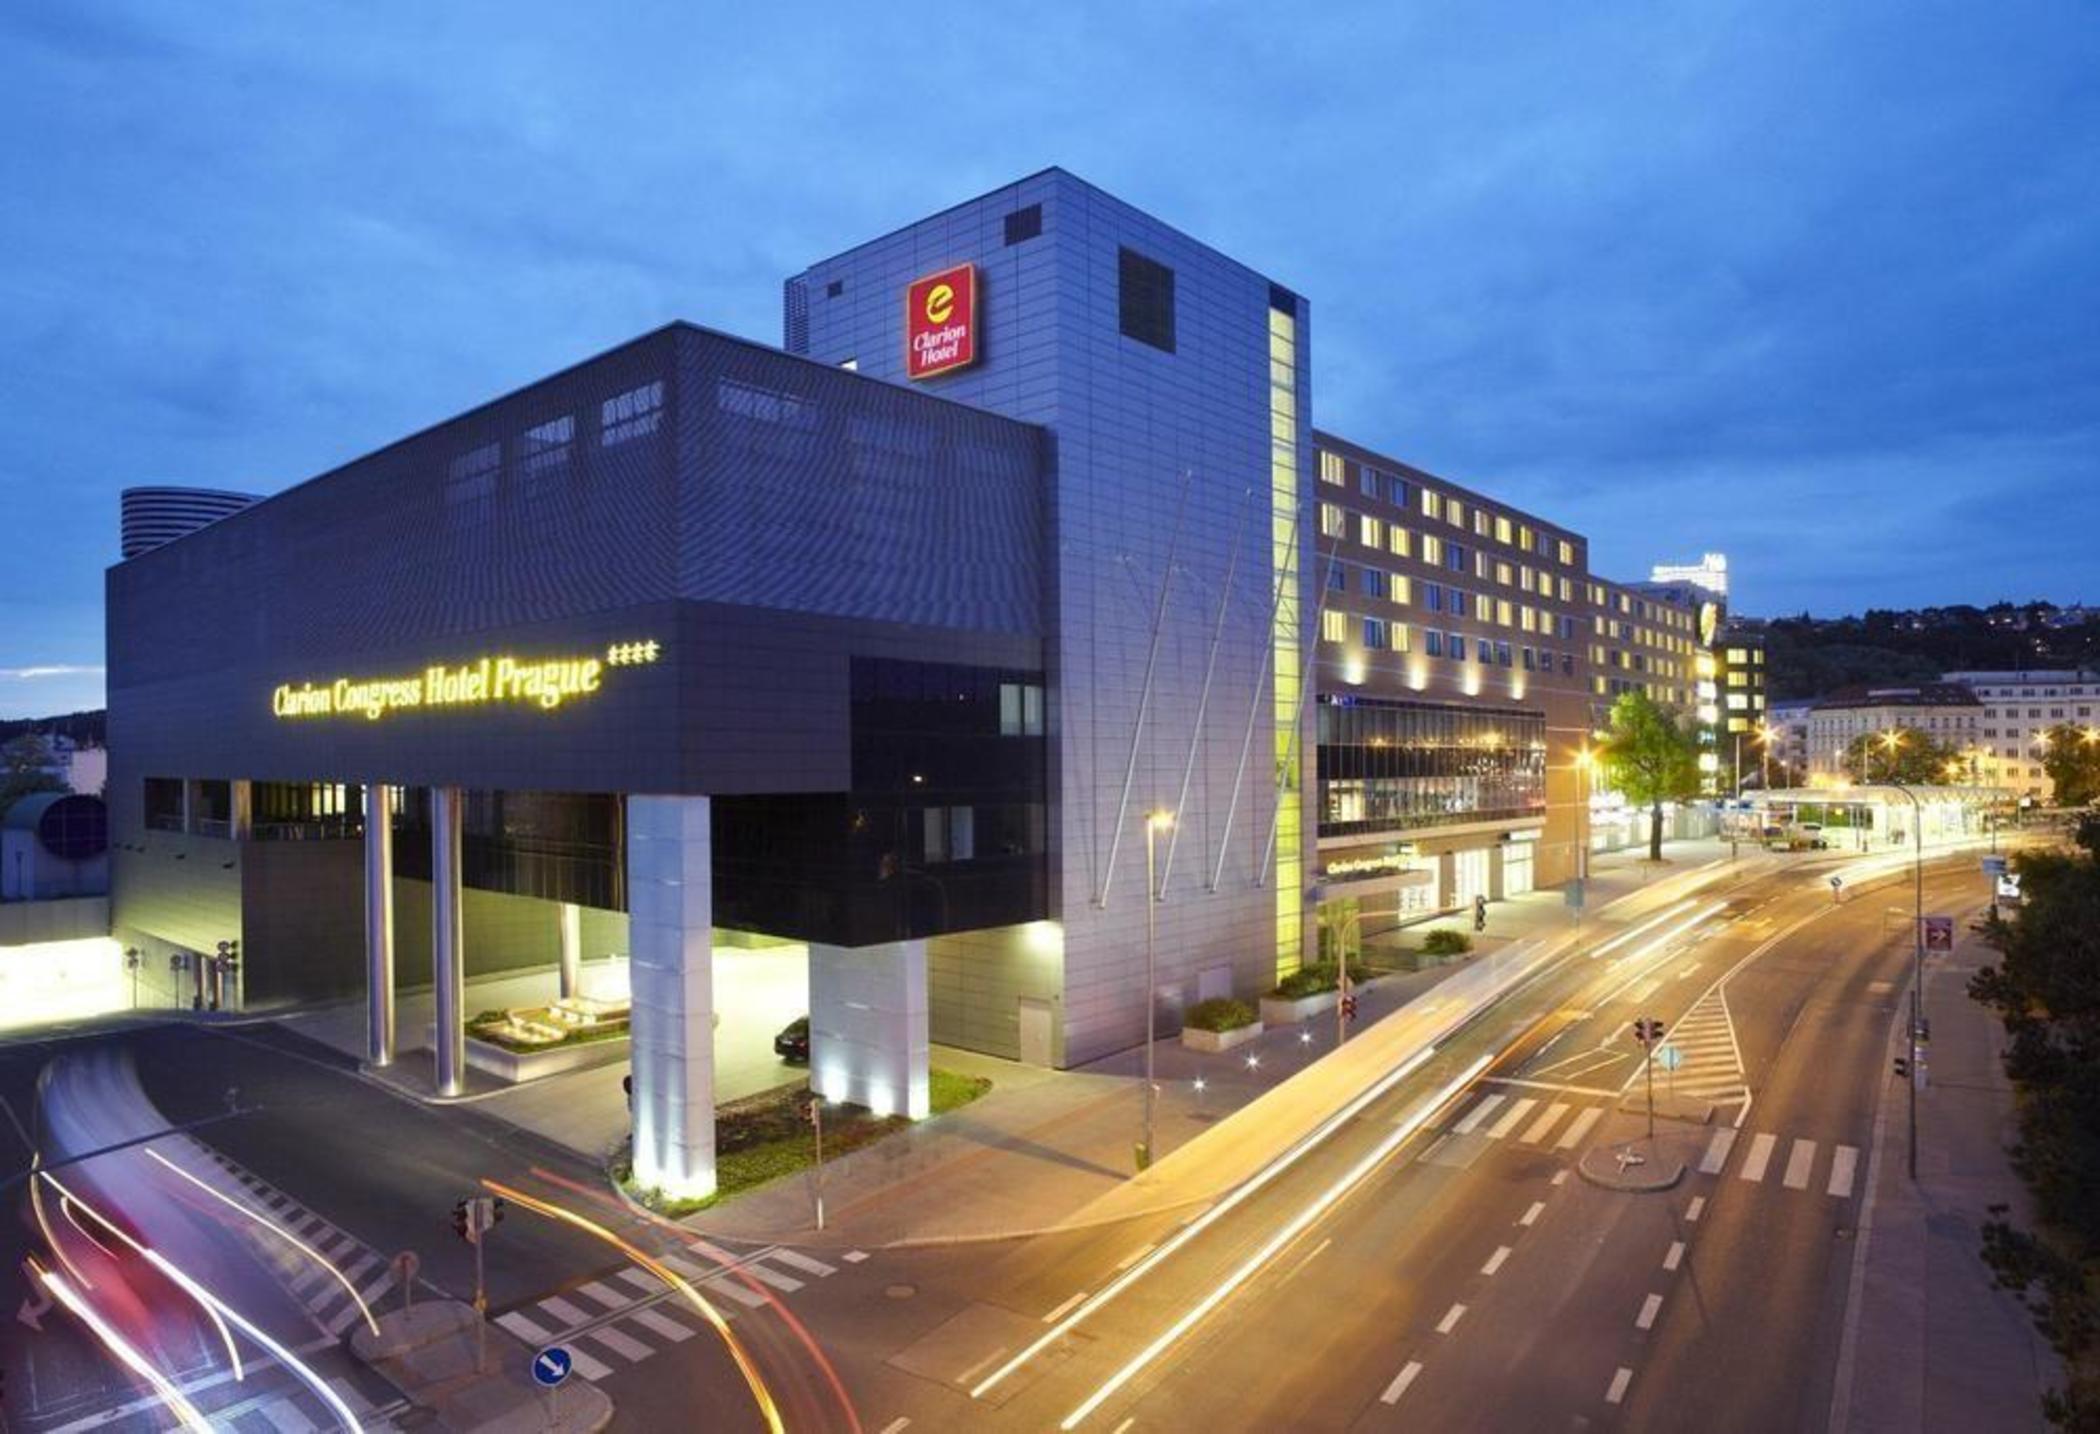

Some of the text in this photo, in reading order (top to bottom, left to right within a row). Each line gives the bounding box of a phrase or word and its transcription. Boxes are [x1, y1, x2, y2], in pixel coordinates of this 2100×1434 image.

[913, 325, 966, 351] Clarion
[921, 339, 959, 367] Hotel
[274, 657, 601, 720] Clarion Congress Hotel Prague
